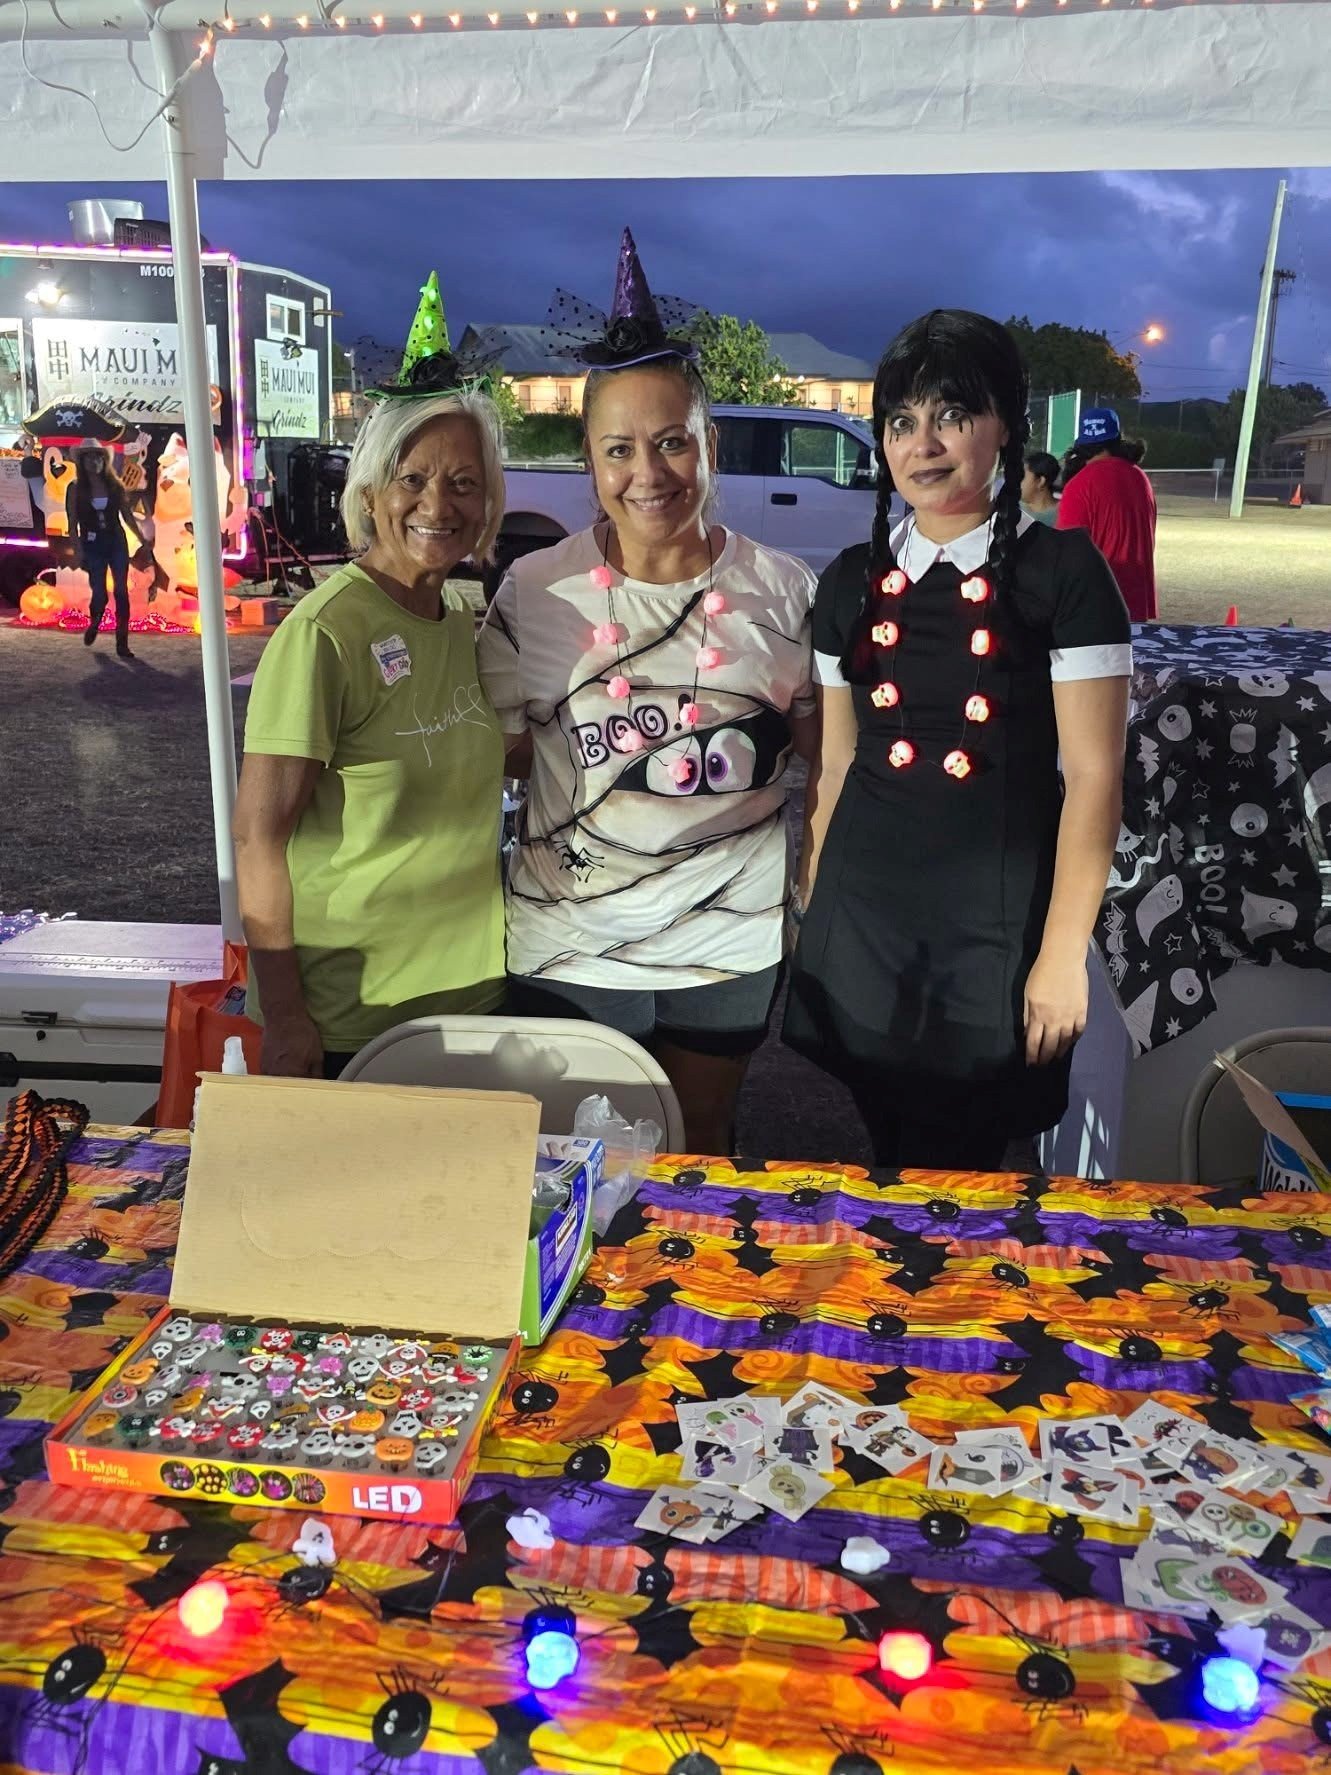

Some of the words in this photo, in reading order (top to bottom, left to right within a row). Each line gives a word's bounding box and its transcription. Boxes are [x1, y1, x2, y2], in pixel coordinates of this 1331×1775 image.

[80, 347, 148, 374] MAUI
[113, 377, 176, 387] COMPANY
[272, 367, 296, 393] MAUI
[298, 370, 315, 395] MUI
[91, 391, 182, 414] rindz
[272, 409, 307, 435] Grindz
[1194, 844, 1229, 914] BOO!
[352, 1485, 422, 1513] LED
